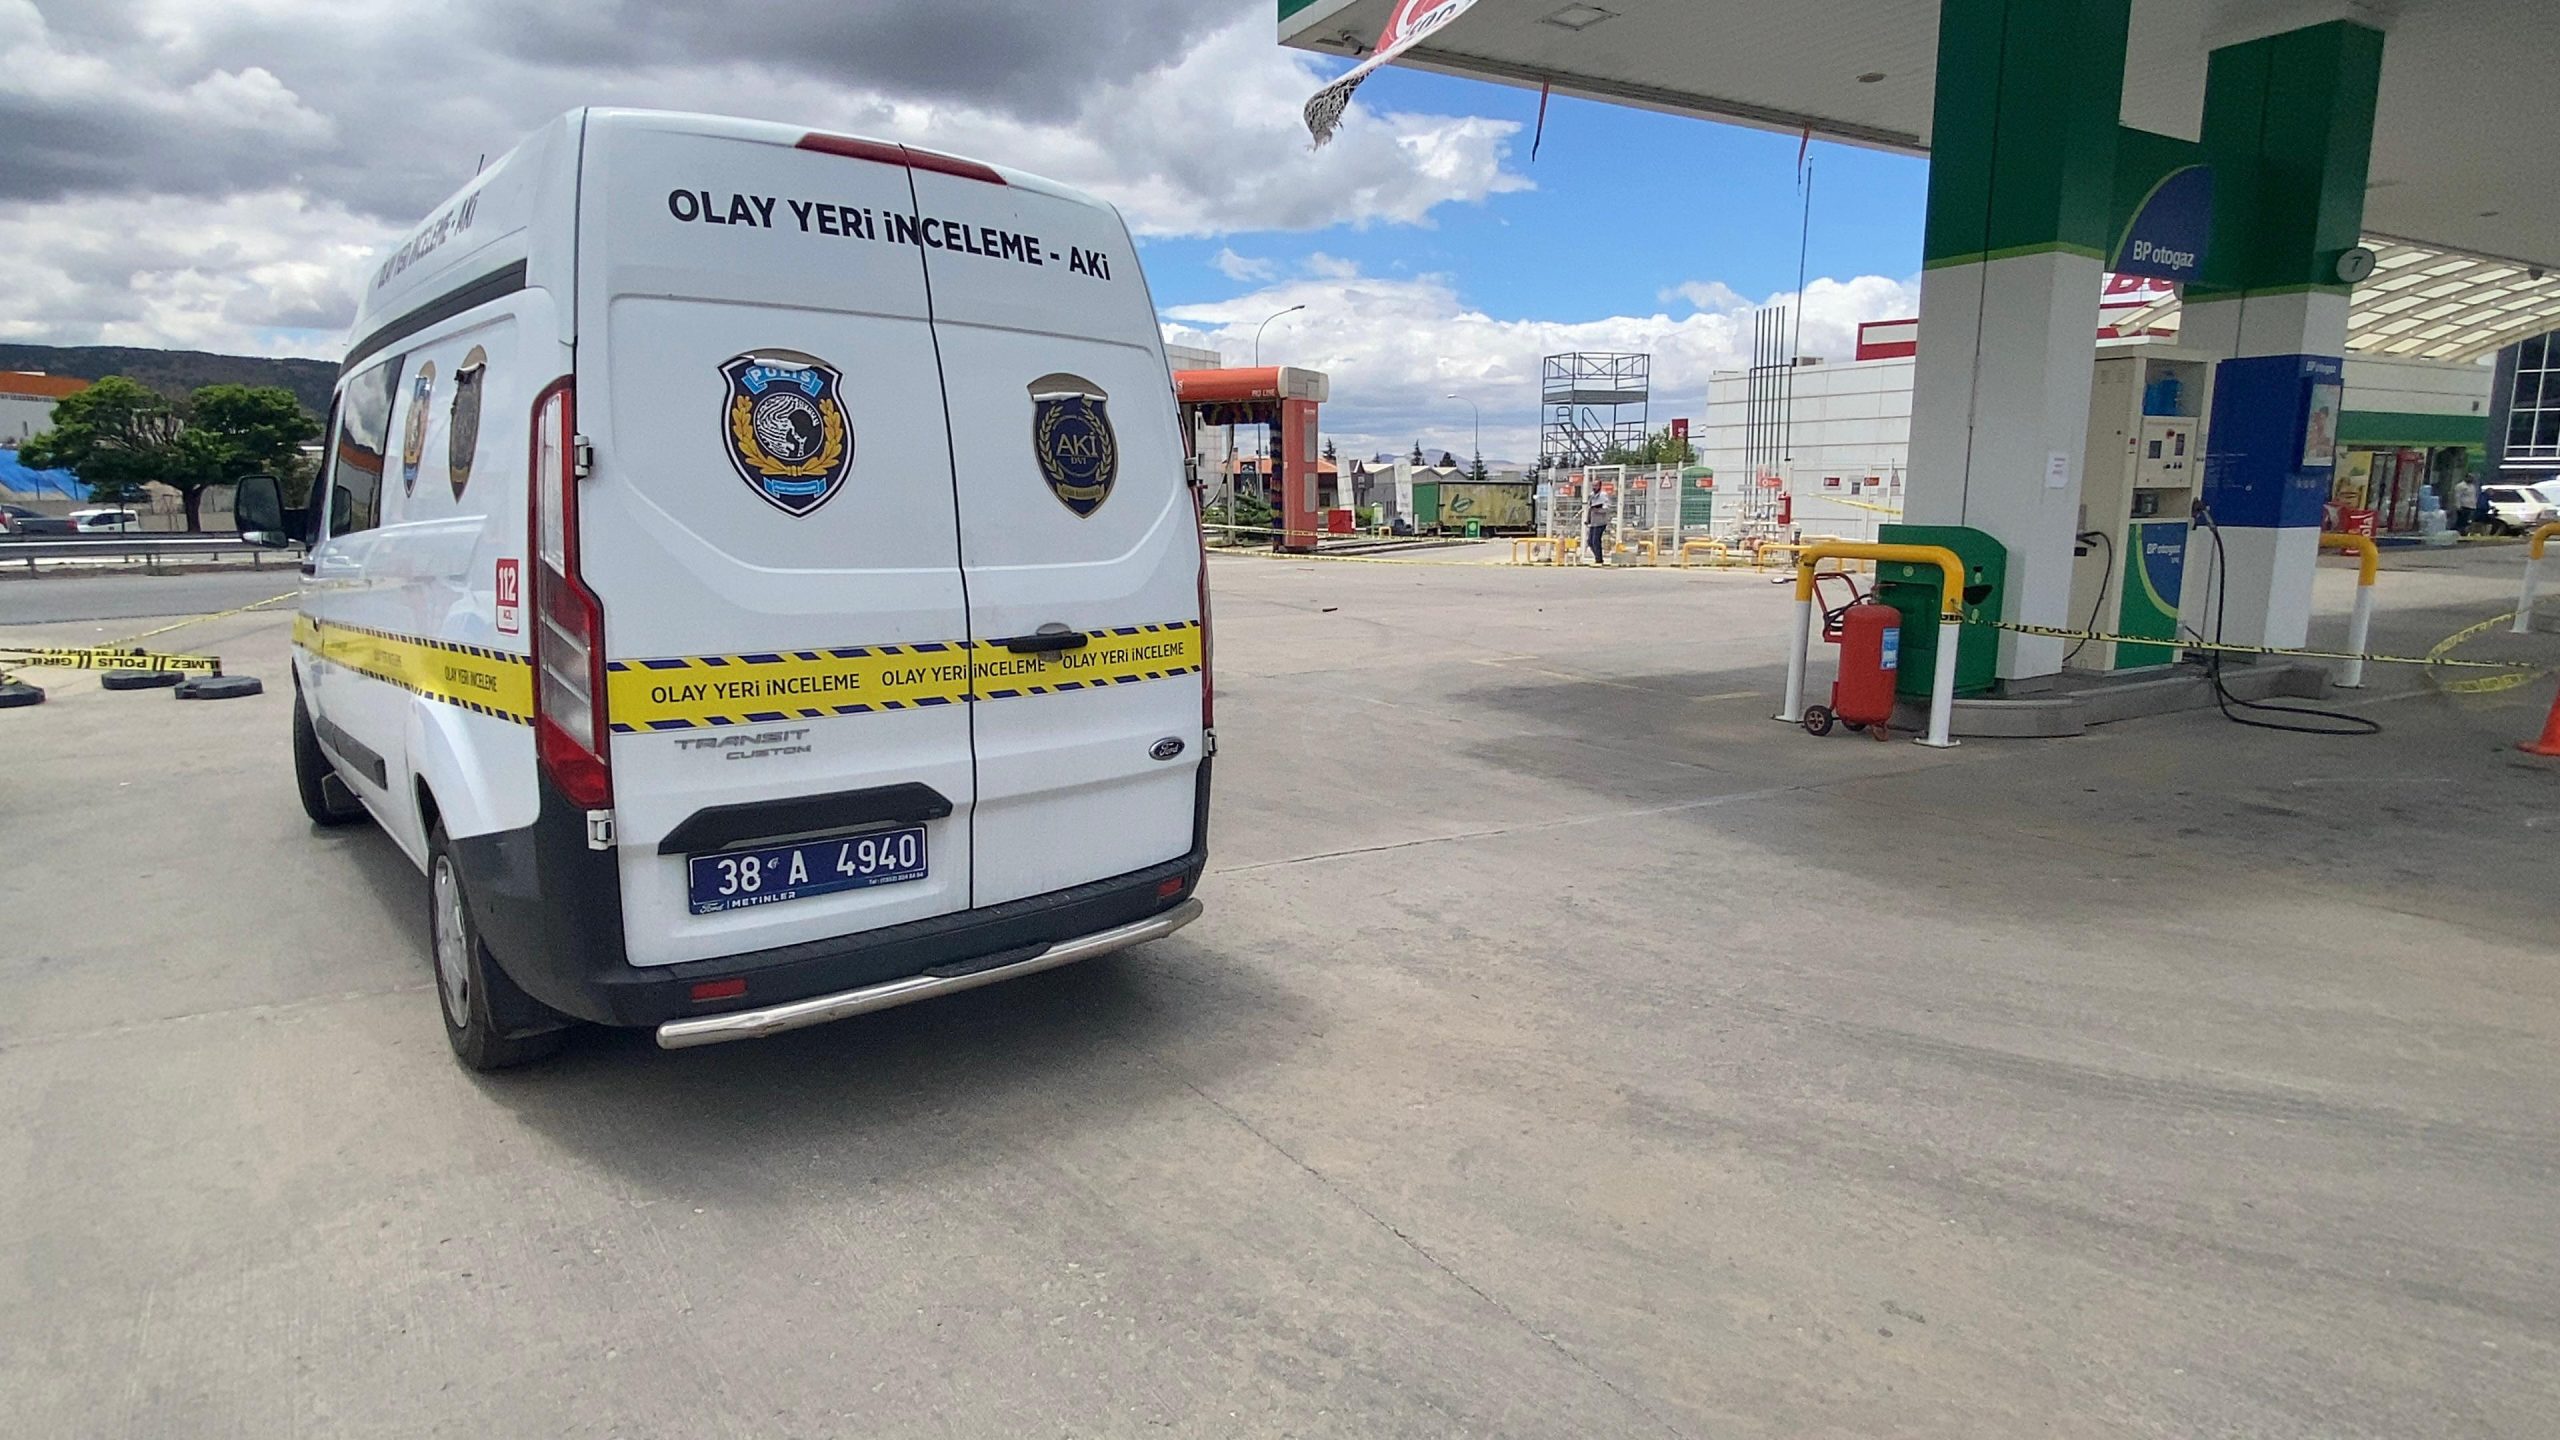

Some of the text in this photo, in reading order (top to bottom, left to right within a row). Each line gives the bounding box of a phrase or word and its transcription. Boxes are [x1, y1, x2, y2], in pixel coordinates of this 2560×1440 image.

[668, 188, 776, 228] OLAY
[787, 199, 875, 240] YERi
[883, 211, 1043, 266] iNCELEME
[1069, 246, 1110, 281] AKi
[2133, 240, 2195, 270] BP otogaz
[1056, 432, 1098, 457] AKİ
[498, 567, 516, 602] 112
[652, 641, 1185, 704] OLAY YERi iNCELEME OLAY YERi iNCELEME OLAY YERi iNCELEME
[674, 728, 810, 750] TRANSIT
[726, 745, 812, 760] CUSTOM
[1155, 740, 1181, 758] Ford
[717, 834, 916, 895] 38 A 4940
